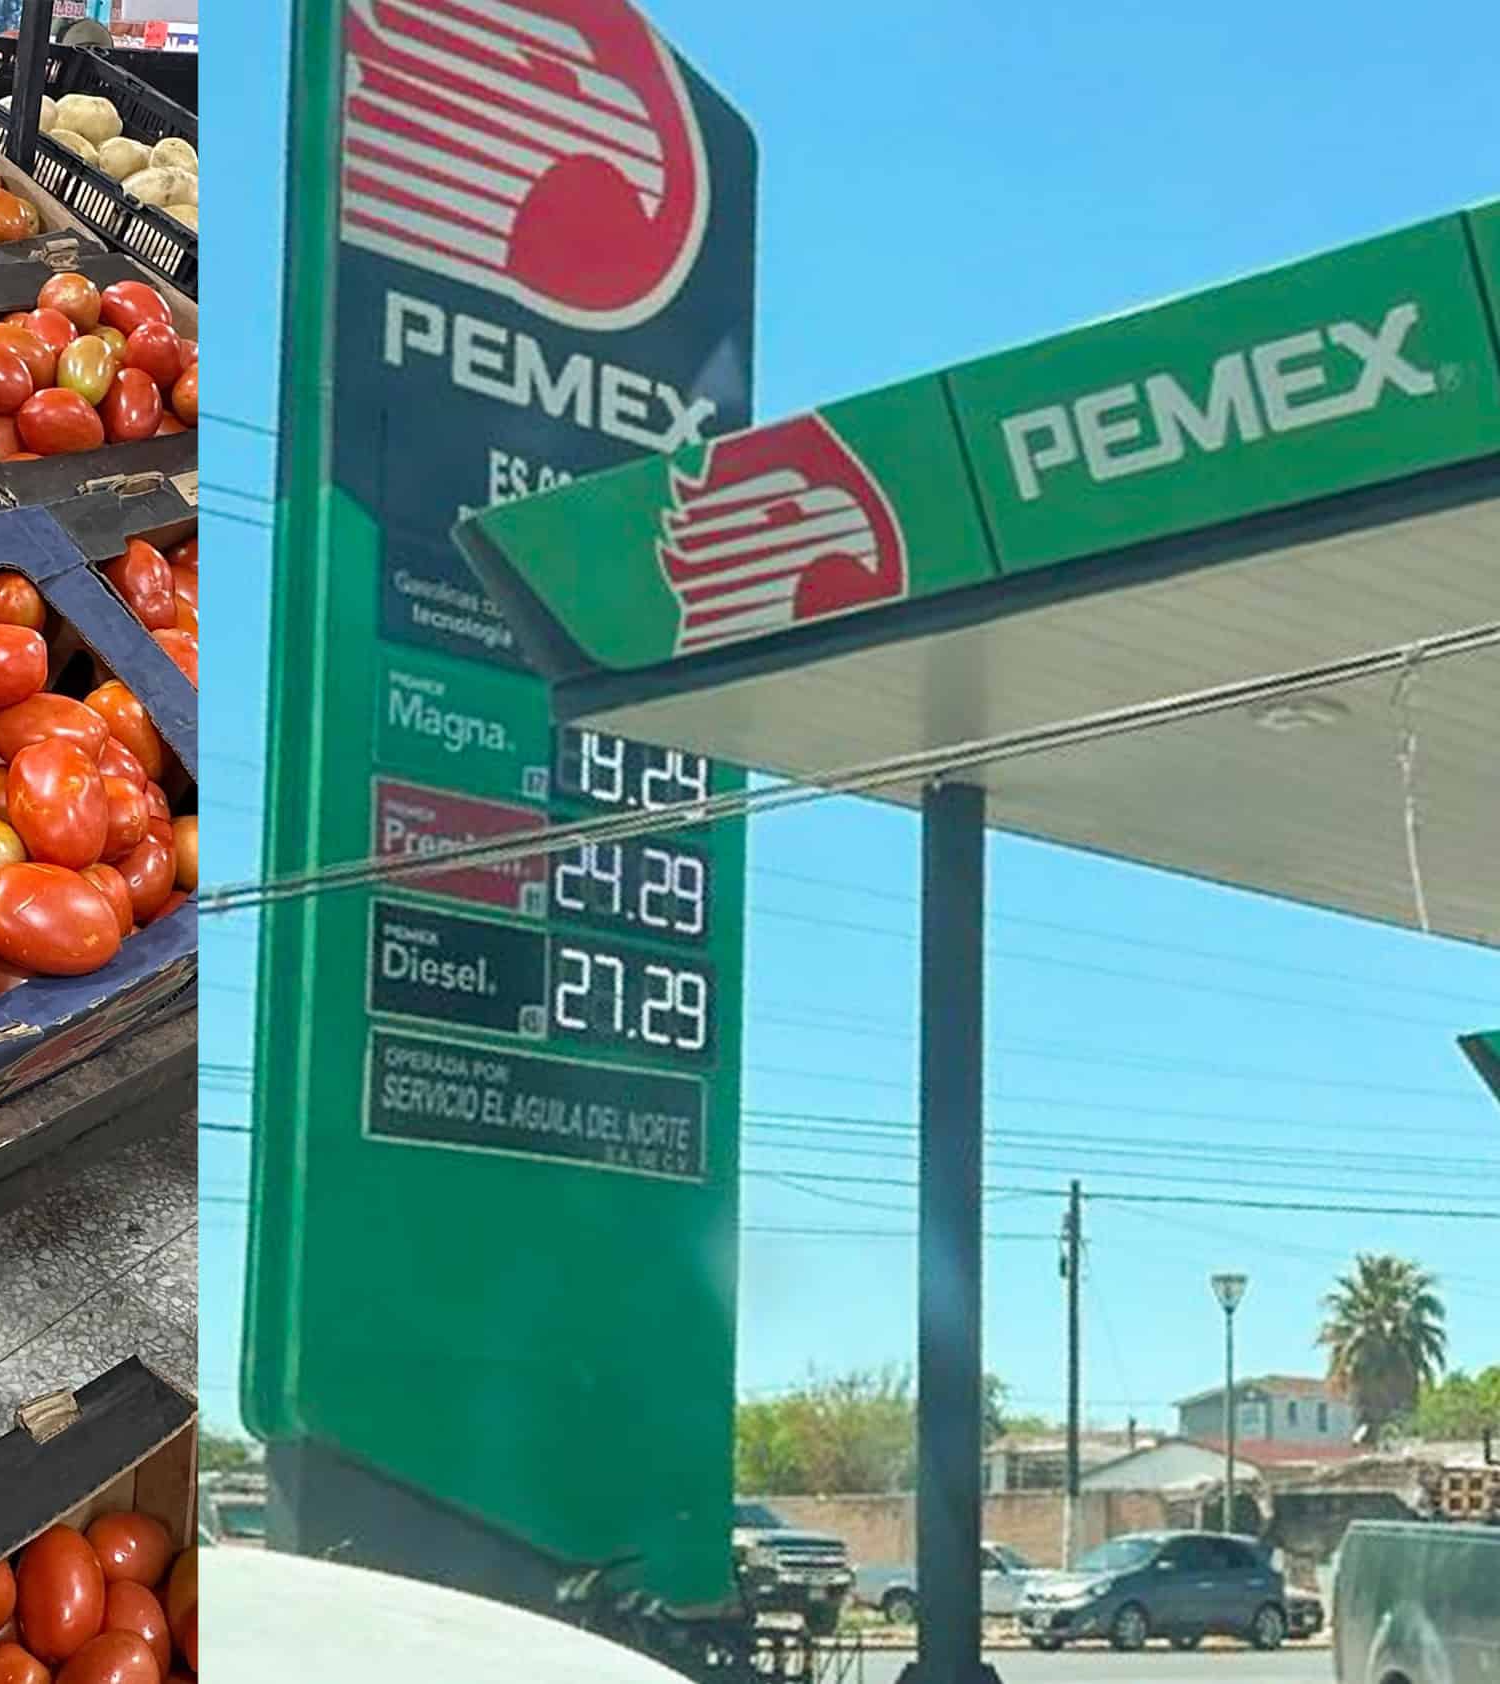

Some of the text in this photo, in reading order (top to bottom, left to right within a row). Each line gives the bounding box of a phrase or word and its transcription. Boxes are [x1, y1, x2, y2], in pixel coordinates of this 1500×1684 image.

[384, 290, 717, 455] PEMEX
[1001, 302, 1437, 501] PEMEX
[555, 948, 707, 1049] 27.29
[381, 1072, 479, 1121] SERVICIO
[481, 1087, 508, 1125] EL
[586, 1103, 623, 1142] DEL
[627, 1111, 692, 1151] NORTE
